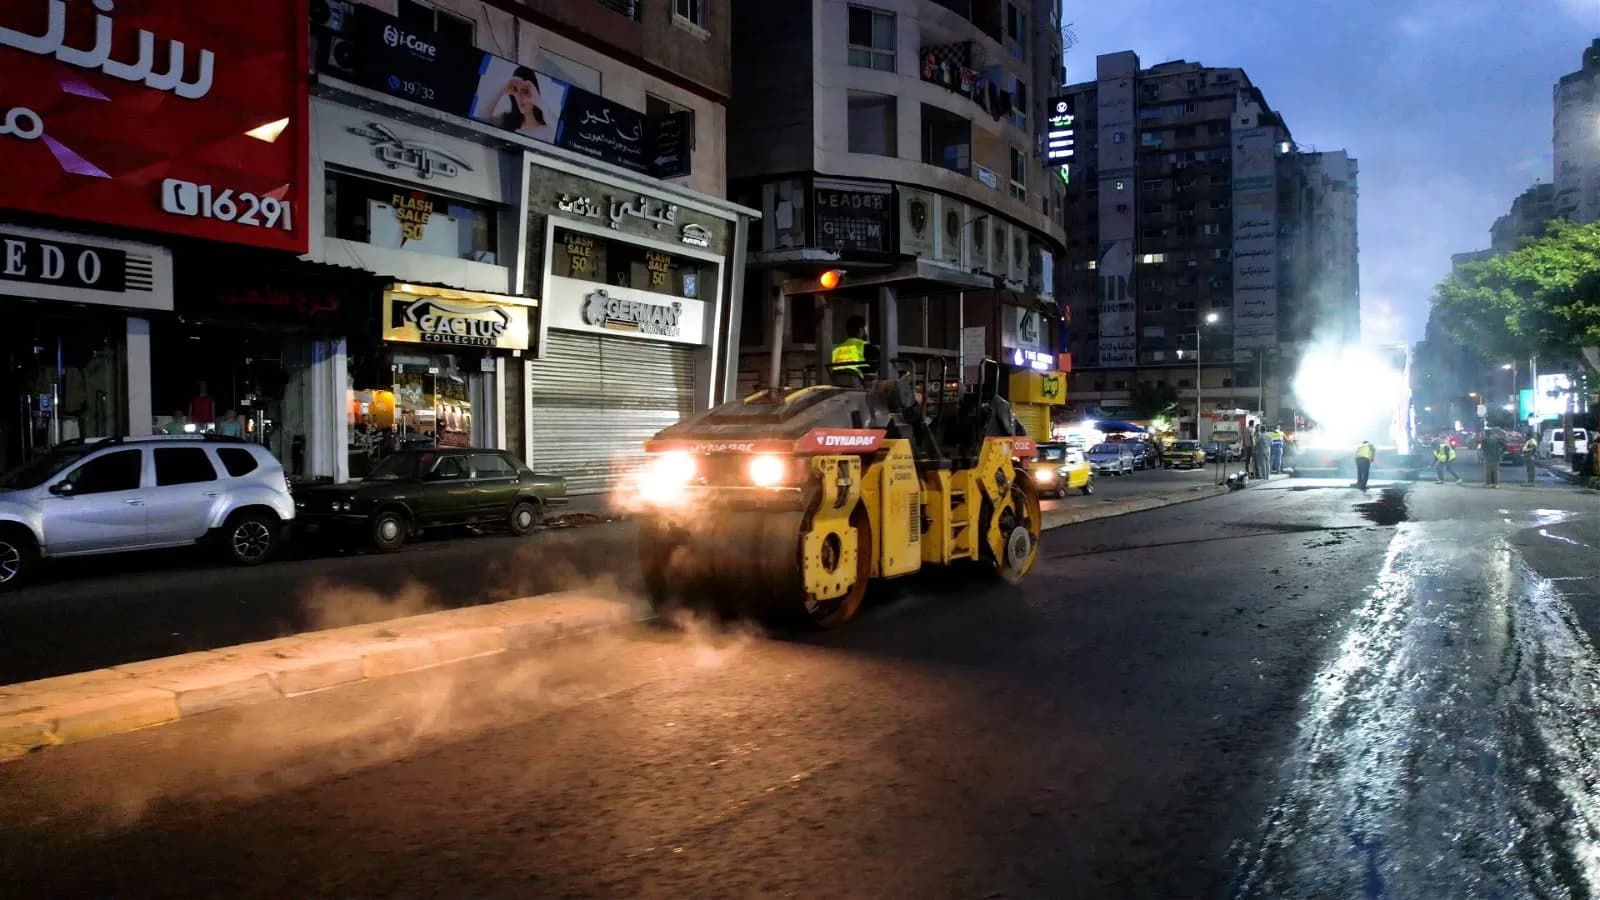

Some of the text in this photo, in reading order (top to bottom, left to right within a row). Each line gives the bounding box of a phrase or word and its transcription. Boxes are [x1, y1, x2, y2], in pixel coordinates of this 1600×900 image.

[399, 31, 436, 56] i-Care
[199, 184, 292, 230] 16291
[392, 194, 433, 213] FLASH
[817, 191, 883, 209] LEADER
[397, 208, 429, 224] SALE
[402, 223, 424, 240] 50
[563, 232, 594, 248] FLASH
[567, 244, 592, 257] SALE
[646, 251, 671, 265] FLASH
[2, 240, 103, 284] EDO
[647, 260, 669, 273] SALE
[607, 297, 682, 326] GERMANY
[419, 314, 505, 338] CACTUS
[424, 333, 498, 346] COLLECTION
